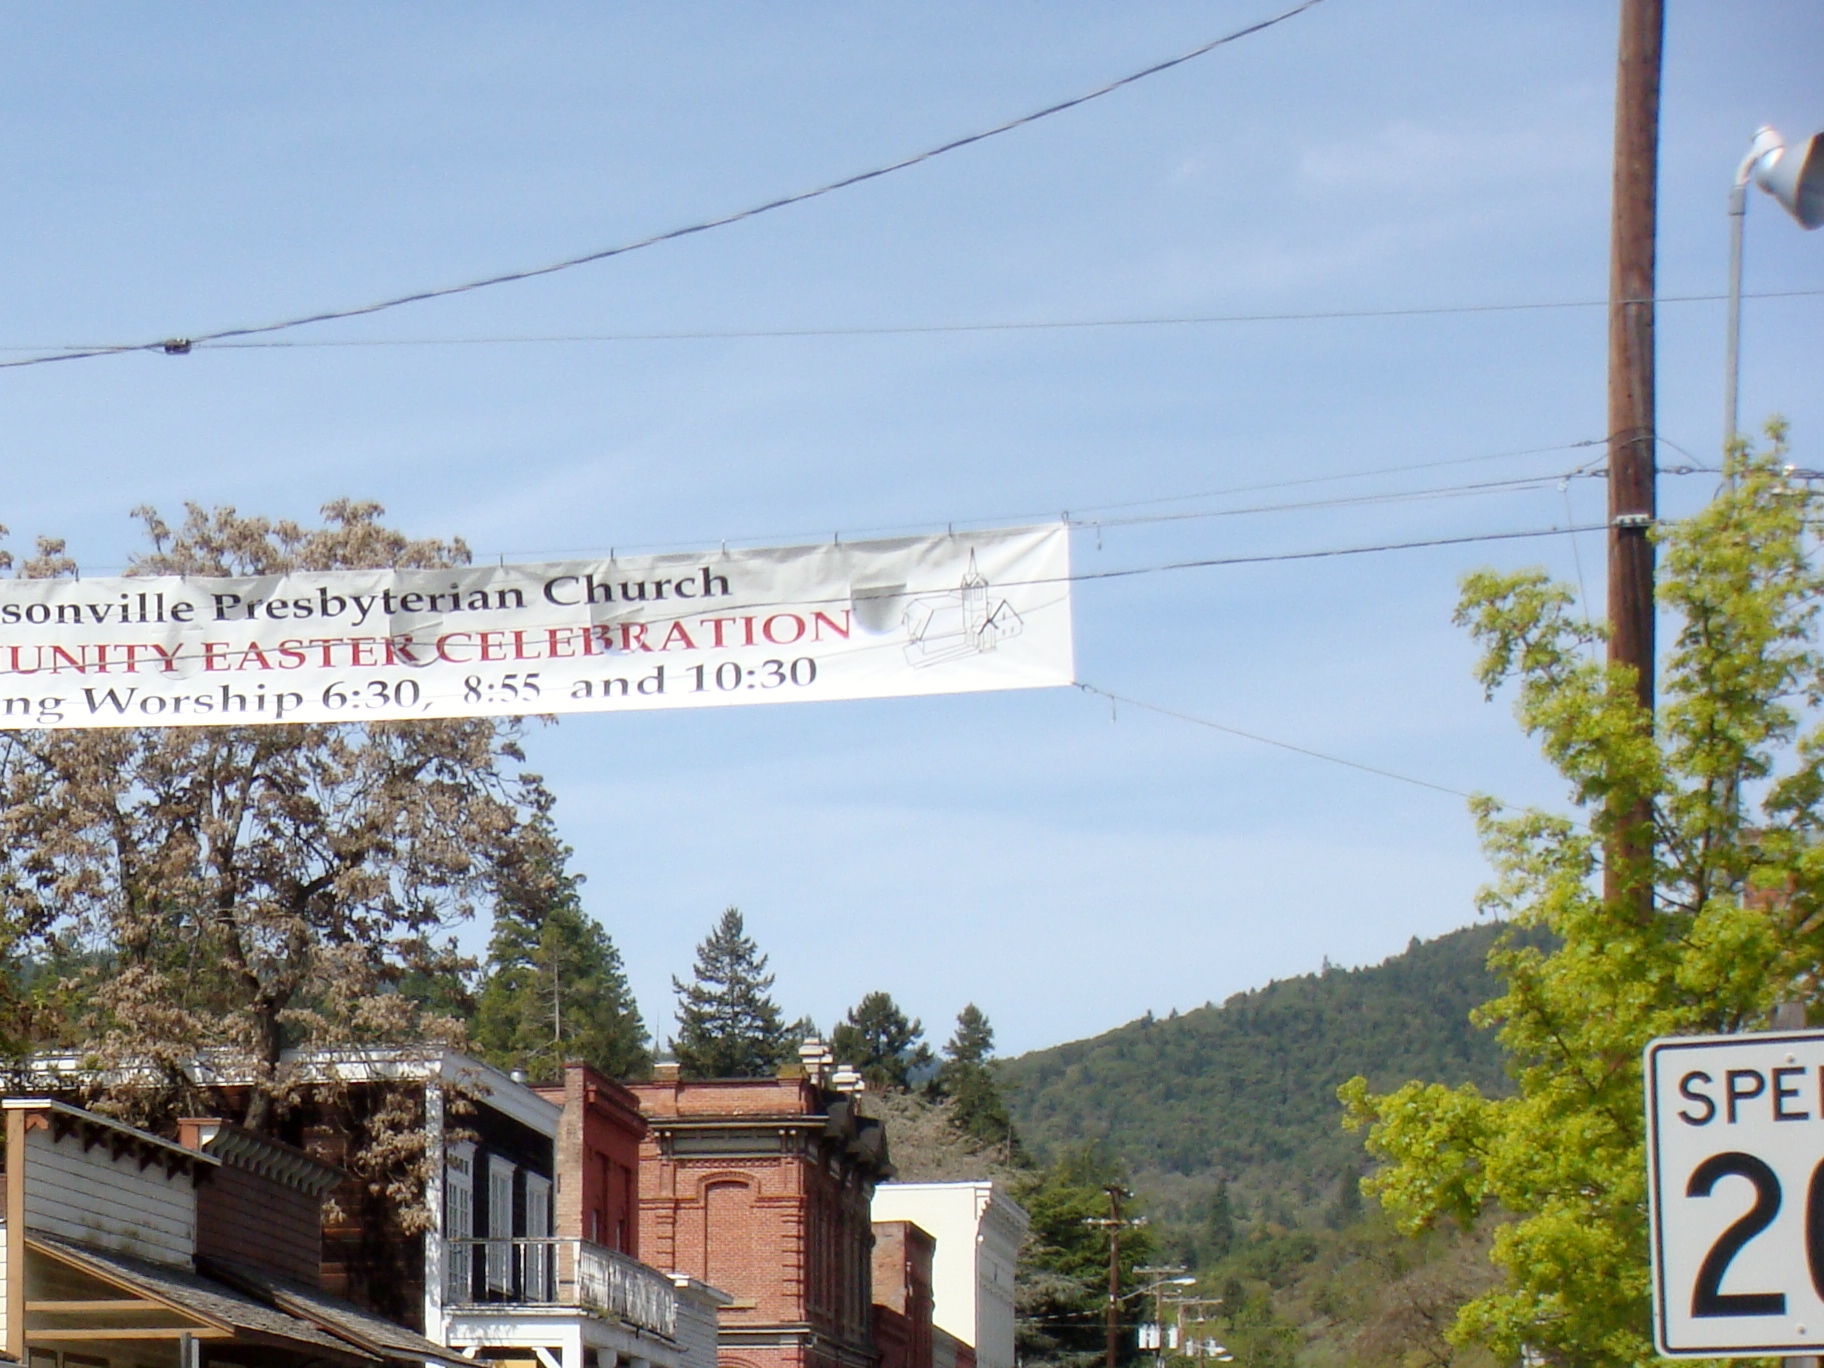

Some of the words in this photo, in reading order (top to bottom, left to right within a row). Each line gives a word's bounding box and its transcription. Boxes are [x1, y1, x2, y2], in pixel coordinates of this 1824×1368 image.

[211, 582, 525, 626] Presbyterian
[542, 566, 732, 606] Church
[203, 635, 420, 672] EASTER
[436, 609, 852, 664] CELEBRATION
[82, 682, 303, 720] Worship
[321, 679, 433, 713] 6:30,
[462, 672, 542, 704] 8:55
[570, 662, 666, 699] and
[687, 655, 817, 693] 10:30
[1685, 1152, 1824, 1318] 2
